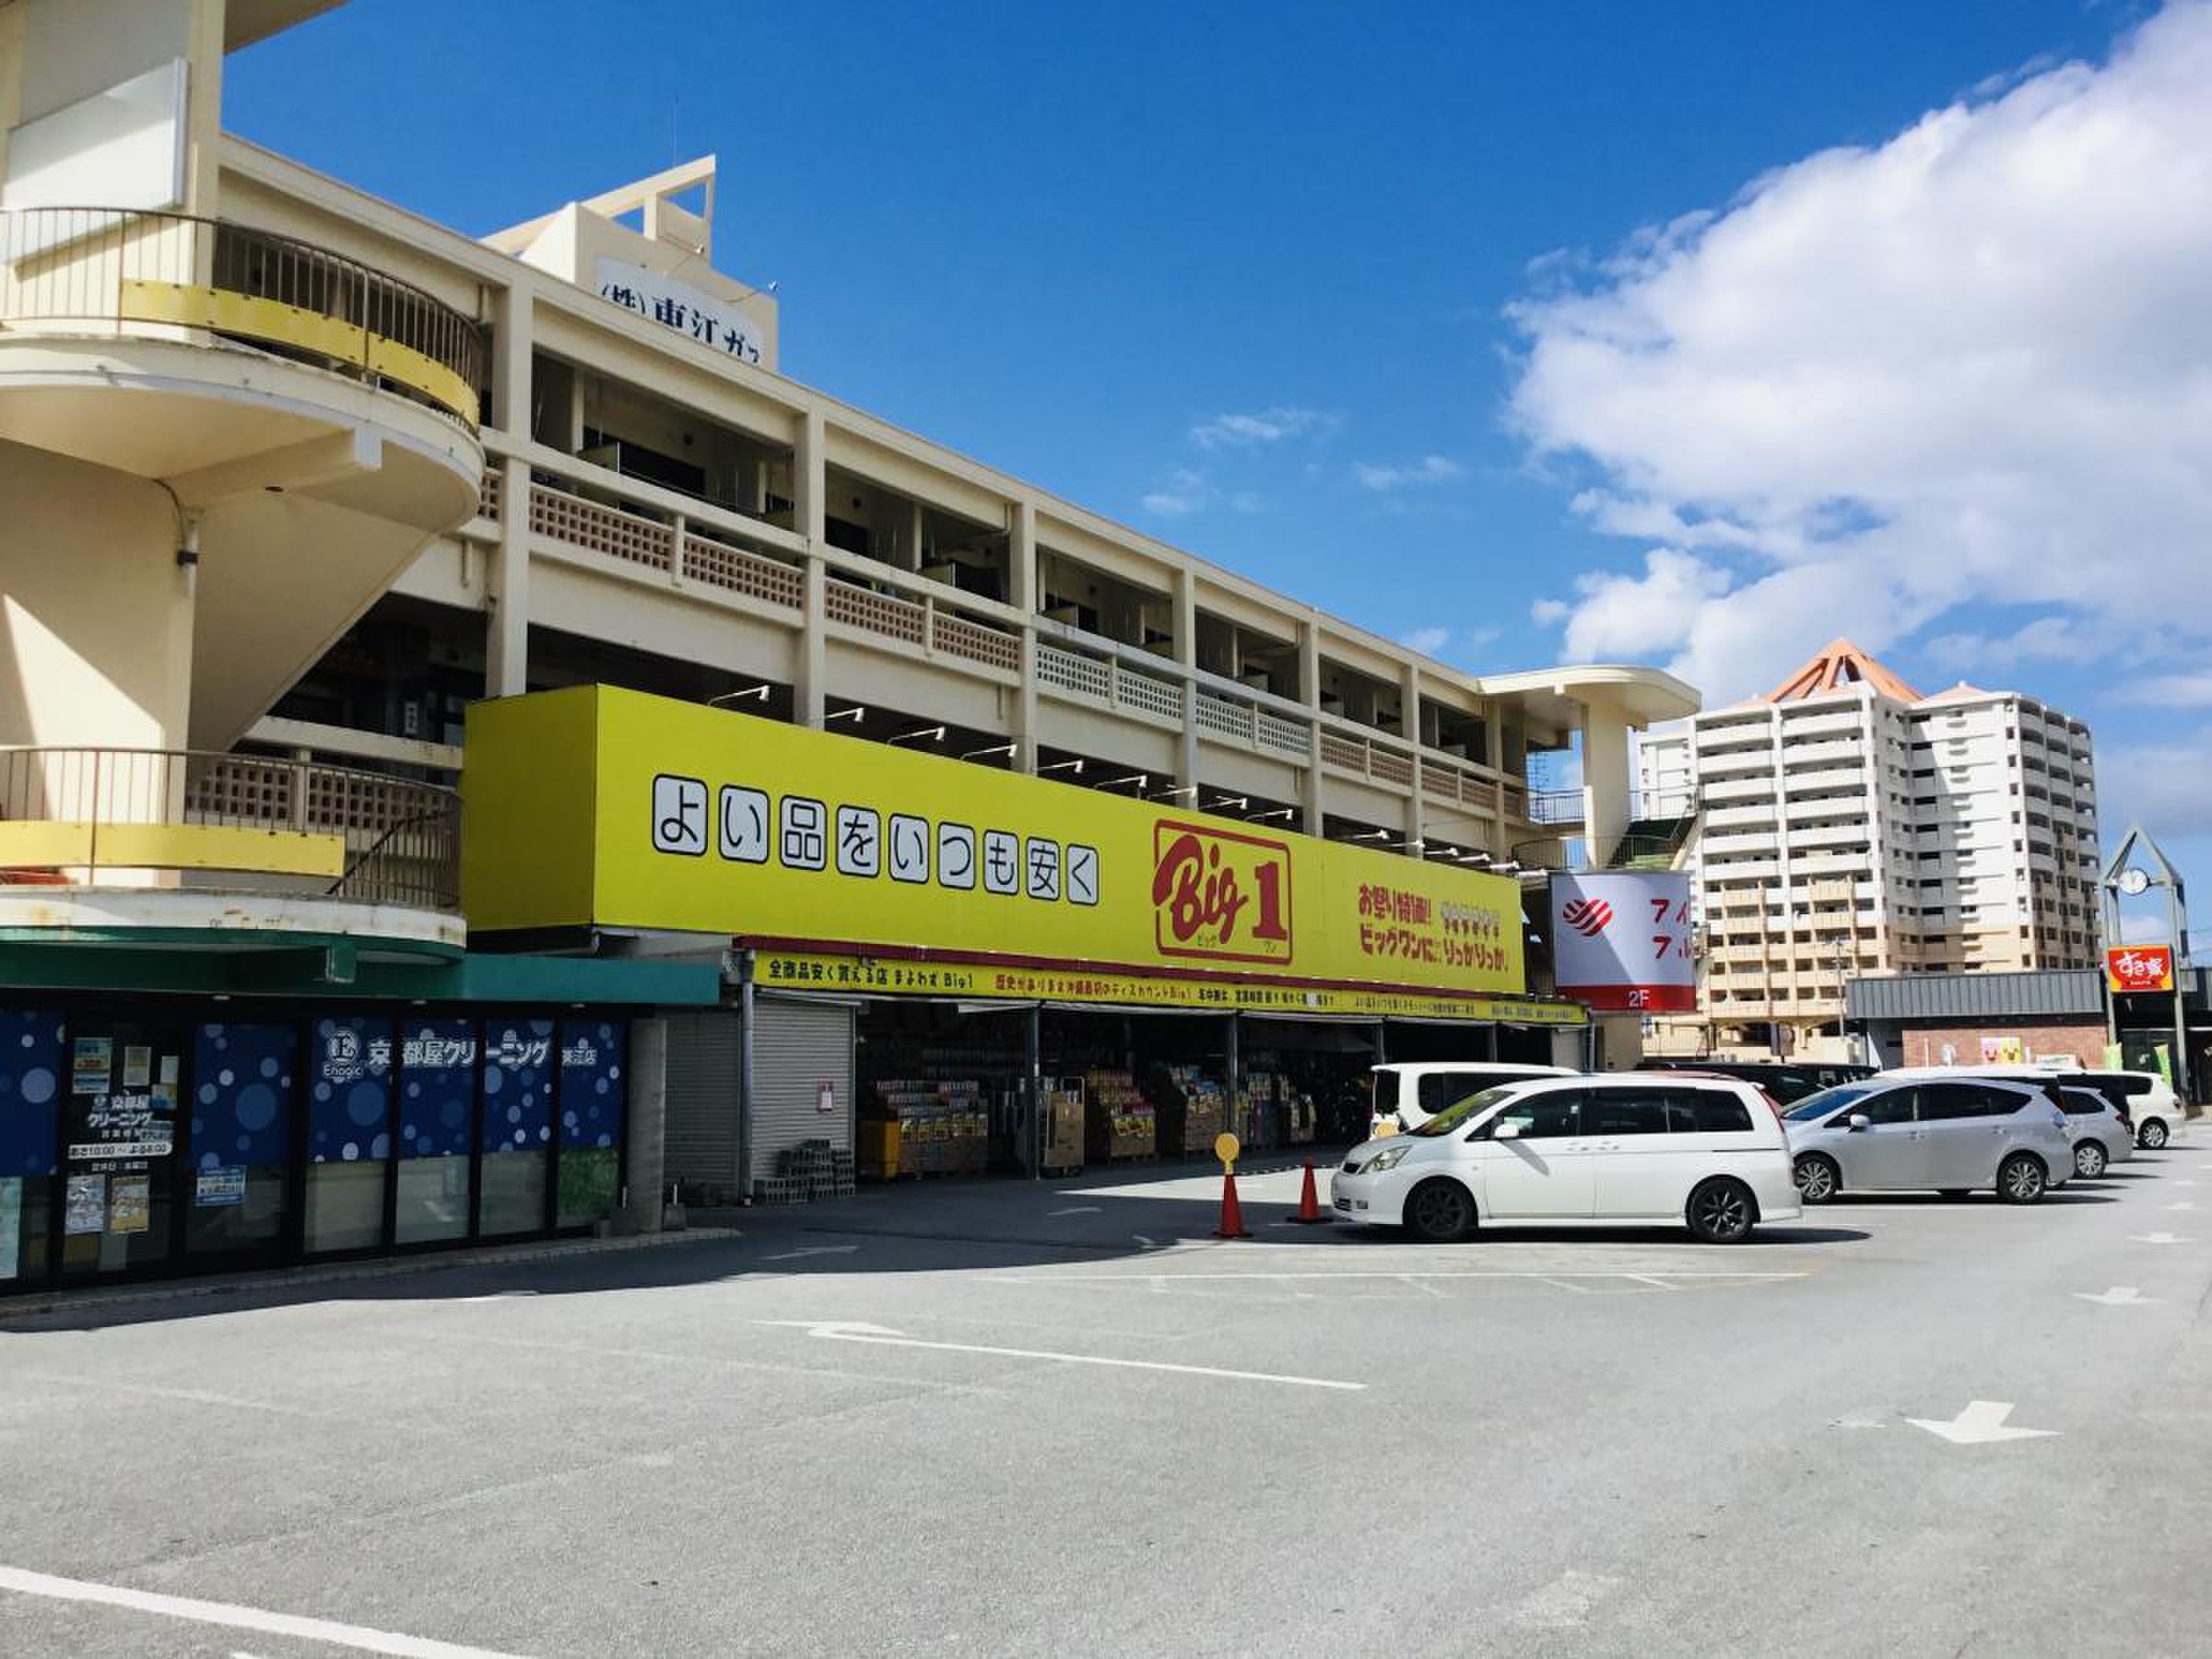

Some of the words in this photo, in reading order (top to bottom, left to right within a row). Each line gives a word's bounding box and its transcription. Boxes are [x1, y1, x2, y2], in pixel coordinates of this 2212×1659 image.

[658, 783, 1093, 900] よい品をいつも安く
[1153, 834, 1249, 945] Big
[1251, 860, 1288, 941] 1
[1628, 990, 1652, 1007] 2F
